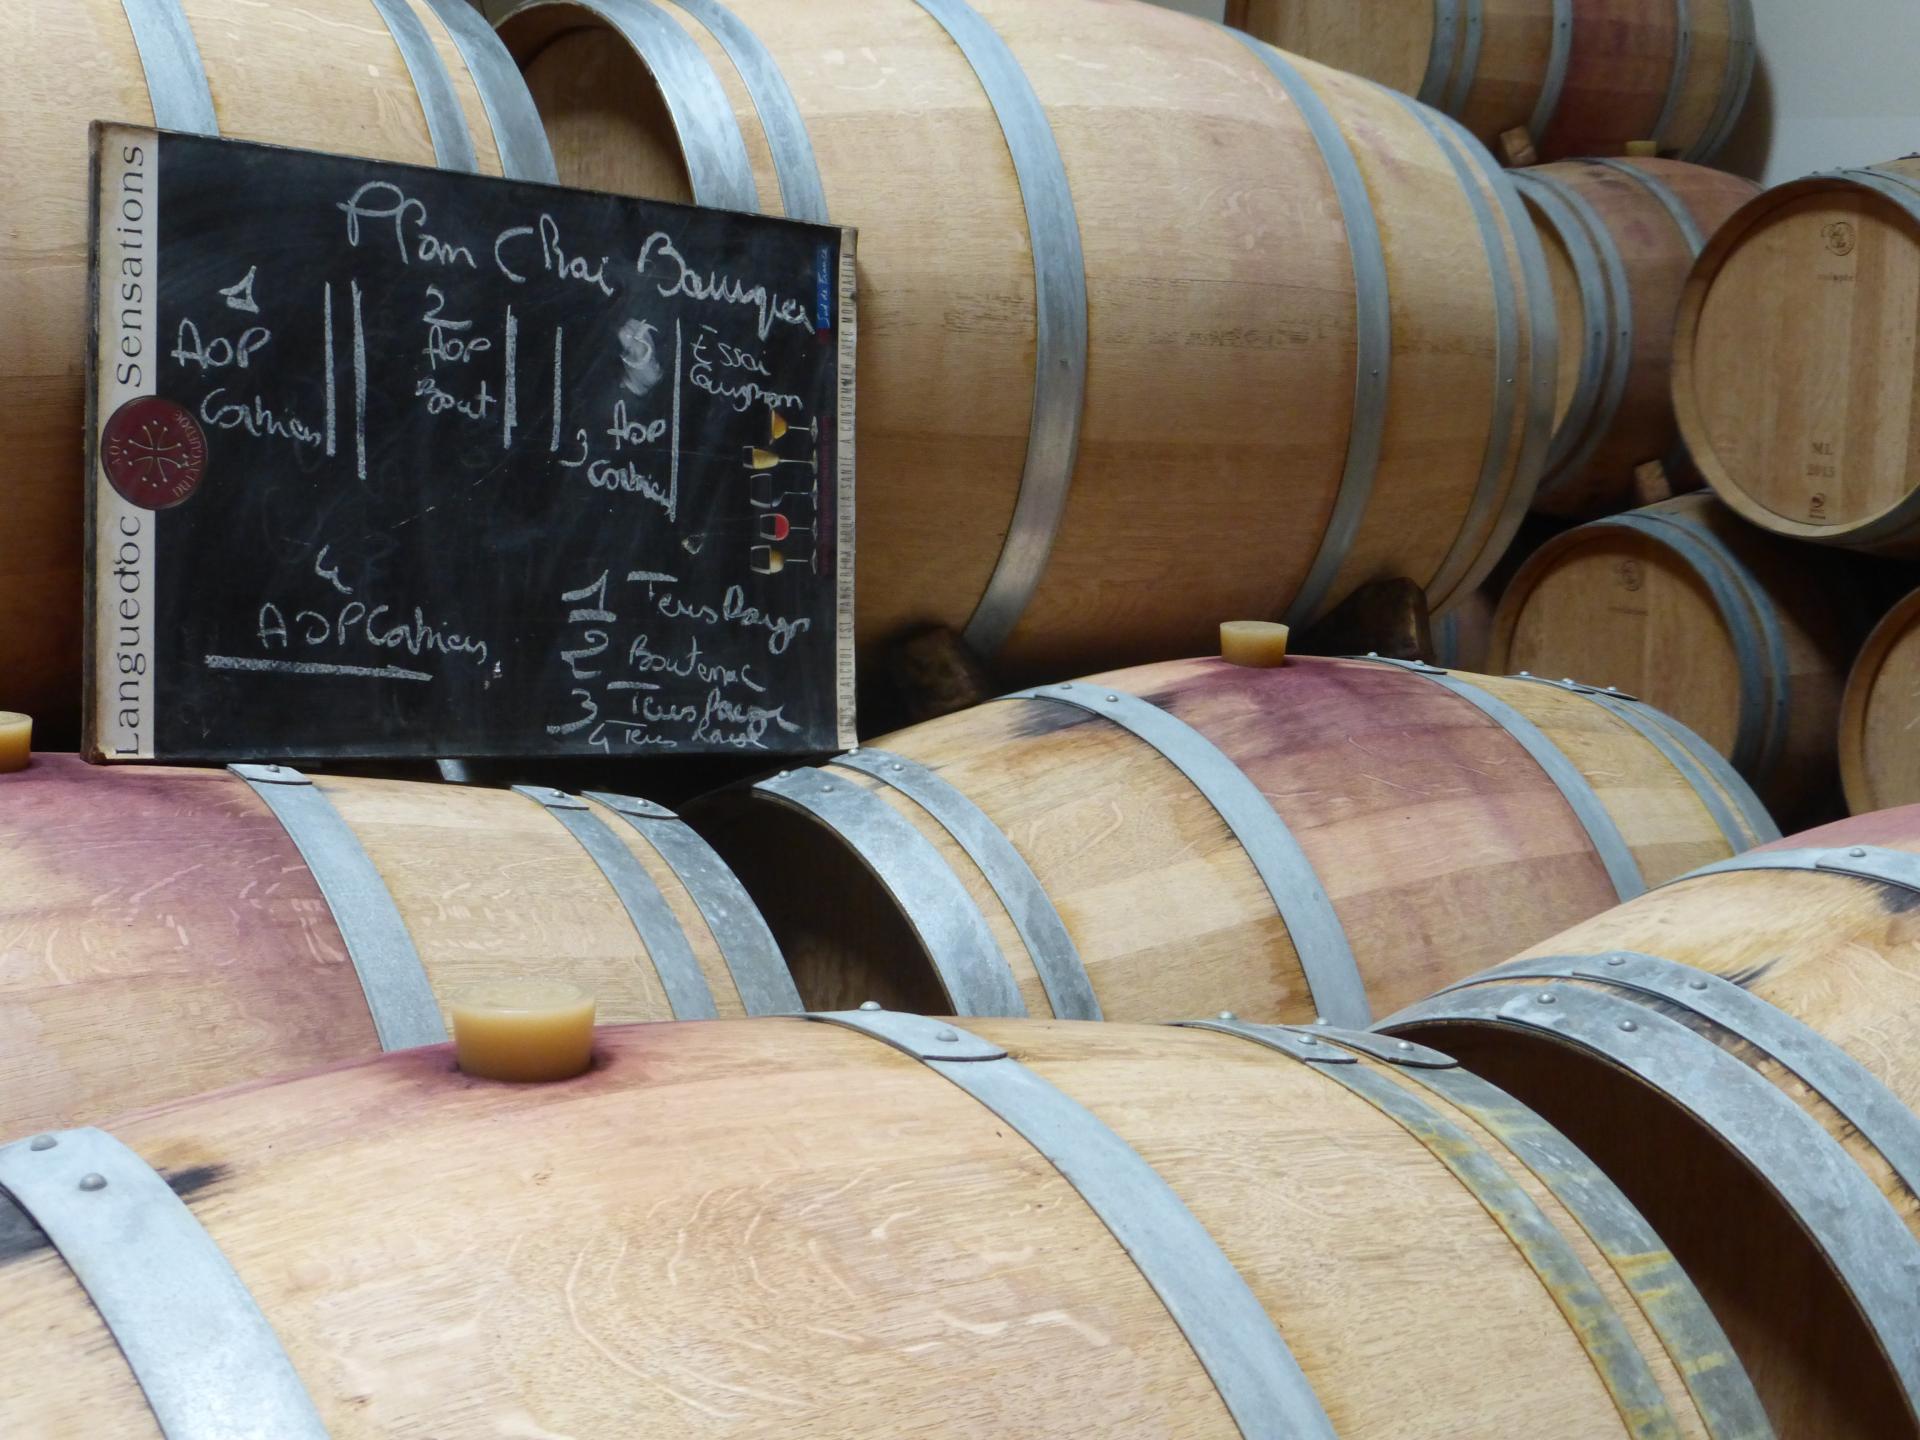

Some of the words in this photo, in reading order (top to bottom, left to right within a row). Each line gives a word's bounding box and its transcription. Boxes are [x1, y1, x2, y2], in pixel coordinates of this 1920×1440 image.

[116, 145, 145, 388] Sensations
[816, 304, 831, 329] Sud
[109, 435, 121, 465] AOC
